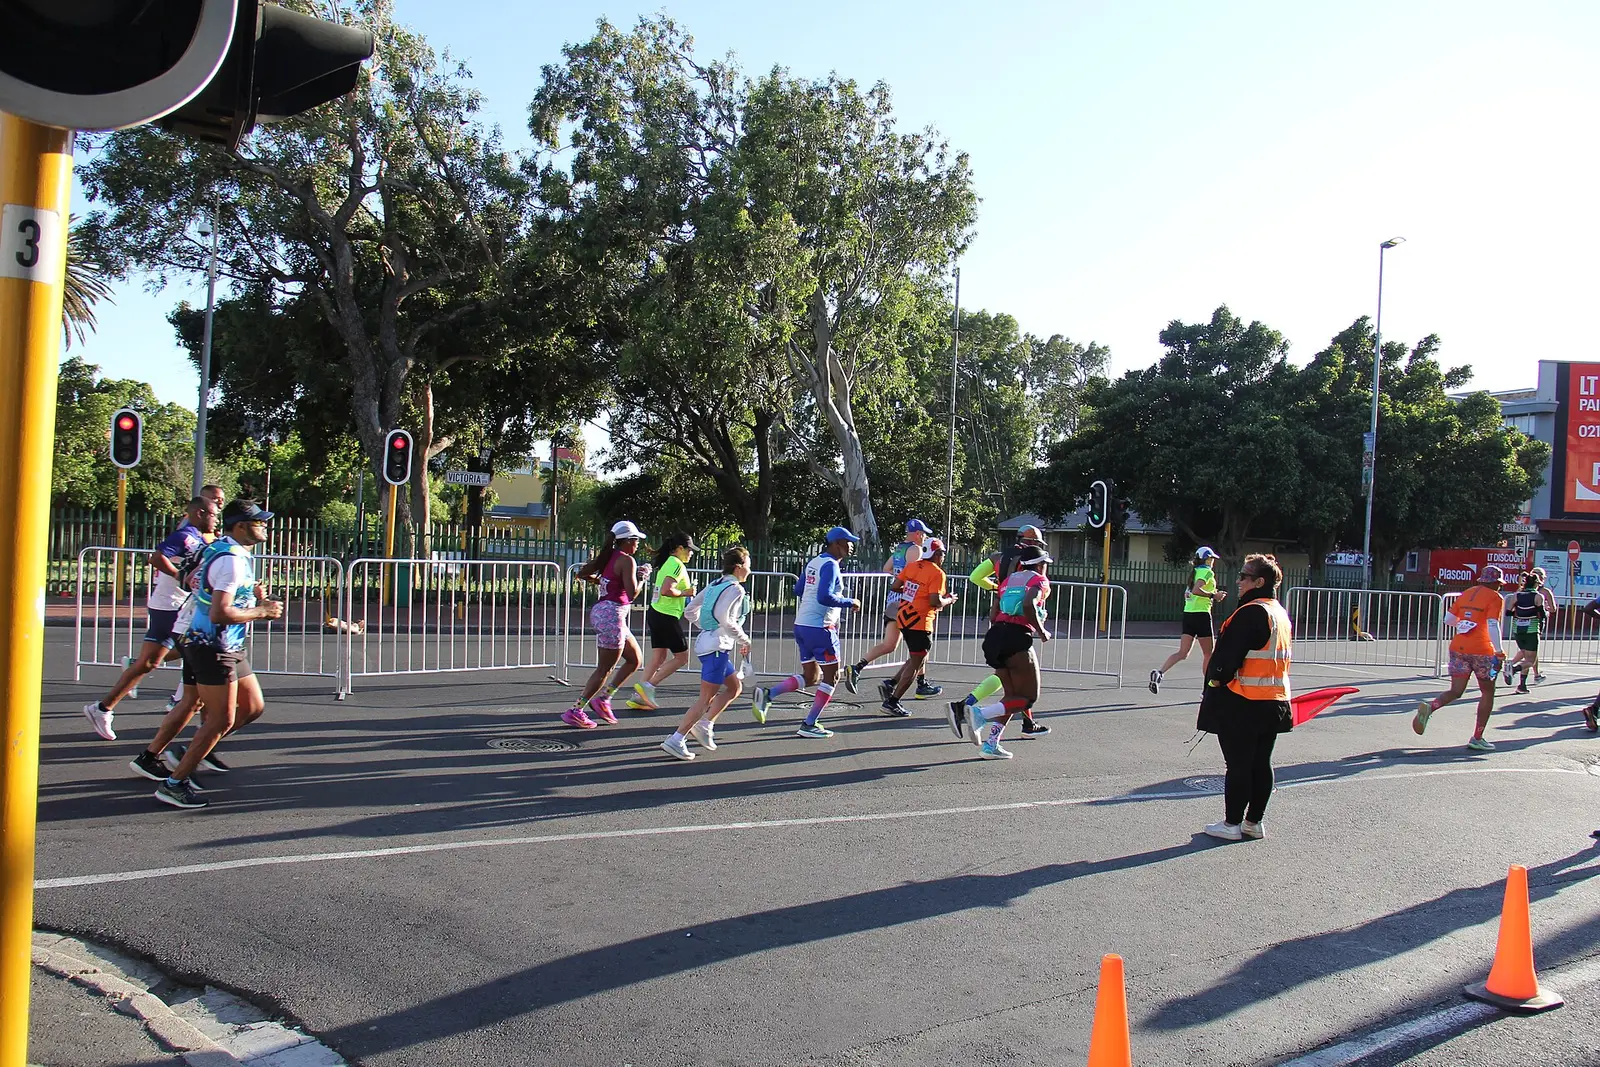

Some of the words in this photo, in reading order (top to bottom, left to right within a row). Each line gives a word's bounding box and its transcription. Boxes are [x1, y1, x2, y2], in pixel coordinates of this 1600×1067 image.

[15, 219, 41, 268] 3
[1580, 376, 1598, 395] LT
[449, 473, 481, 483] VICTORIA
[1505, 524, 1531, 532] ABERDEEN
[1439, 568, 1472, 580] Plascon
